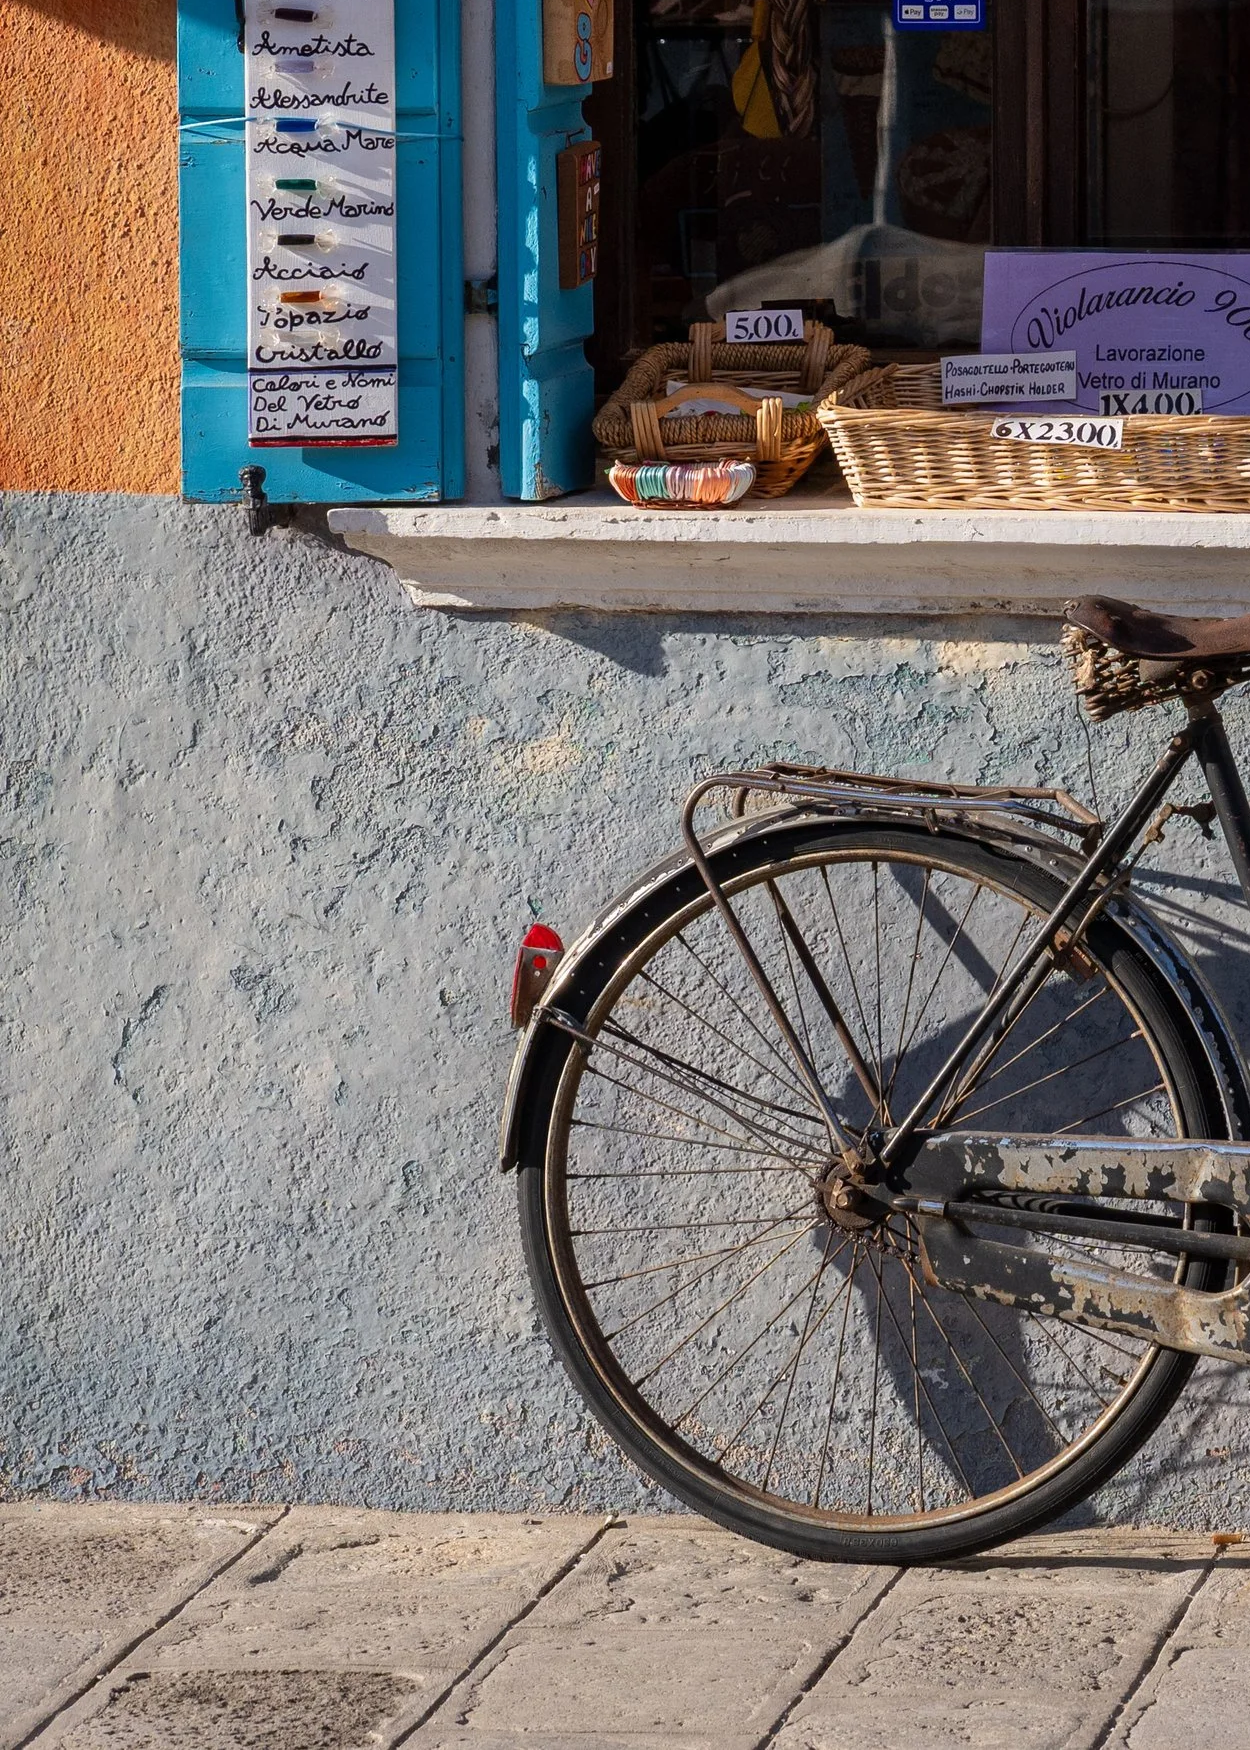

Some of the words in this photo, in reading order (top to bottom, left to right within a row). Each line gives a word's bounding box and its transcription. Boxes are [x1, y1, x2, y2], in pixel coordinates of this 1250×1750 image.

[910, 8, 922, 17] Pay
[252, 31, 375, 57] Ametista
[249, 81, 389, 109] Alessandrite
[254, 136, 342, 158] Acqua
[342, 129, 395, 152] Mare
[250, 199, 322, 222] Verde
[323, 196, 394, 219] Marino
[586, 186, 593, 213] A
[253, 257, 370, 281] Acciaio
[257, 305, 371, 330] Topazio
[1026, 280, 1197, 350] Violarancio
[256, 338, 383, 364] Cristallo
[1095, 344, 1206, 363] Lavorazione
[252, 375, 319, 393] Colori
[325, 379, 338, 390] e
[342, 371, 397, 389] Nomi
[1029, 381, 1066, 396] HOLDER
[1078, 372, 1130, 389] Vetro
[1131, 371, 1147, 389] di
[1152, 372, 1221, 389] Murano
[253, 396, 287, 413] Del
[298, 393, 361, 413] Vetro
[256, 415, 284, 434] Di
[286, 411, 389, 433] Murano
